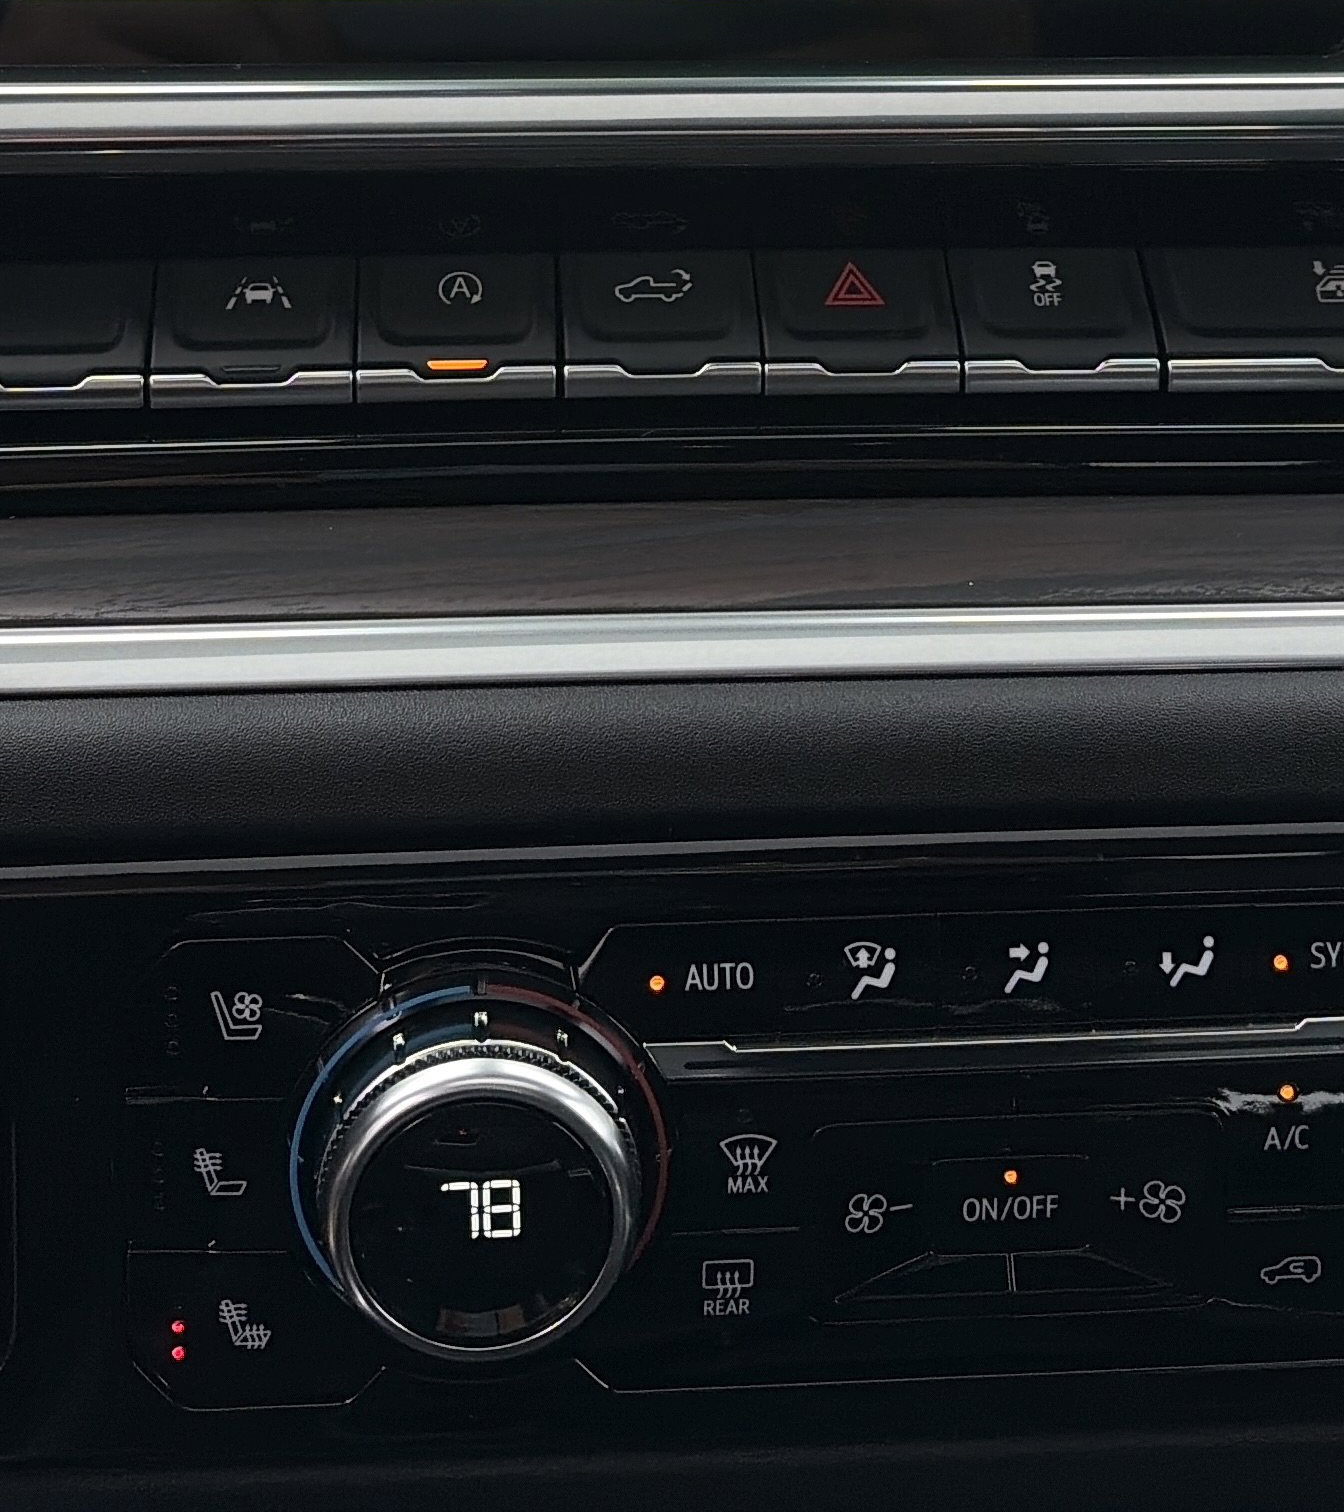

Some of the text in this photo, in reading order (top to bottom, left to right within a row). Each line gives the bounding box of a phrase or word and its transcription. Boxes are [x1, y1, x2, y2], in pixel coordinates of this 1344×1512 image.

[1033, 292, 1062, 307] OFF
[684, 961, 754, 991] AUTO
[1263, 1124, 1309, 1151] A/C
[727, 1175, 769, 1194] MAX
[440, 1179, 521, 1240] 78
[962, 1194, 1059, 1222] ON/OFF
[703, 1298, 750, 1317] REAR
